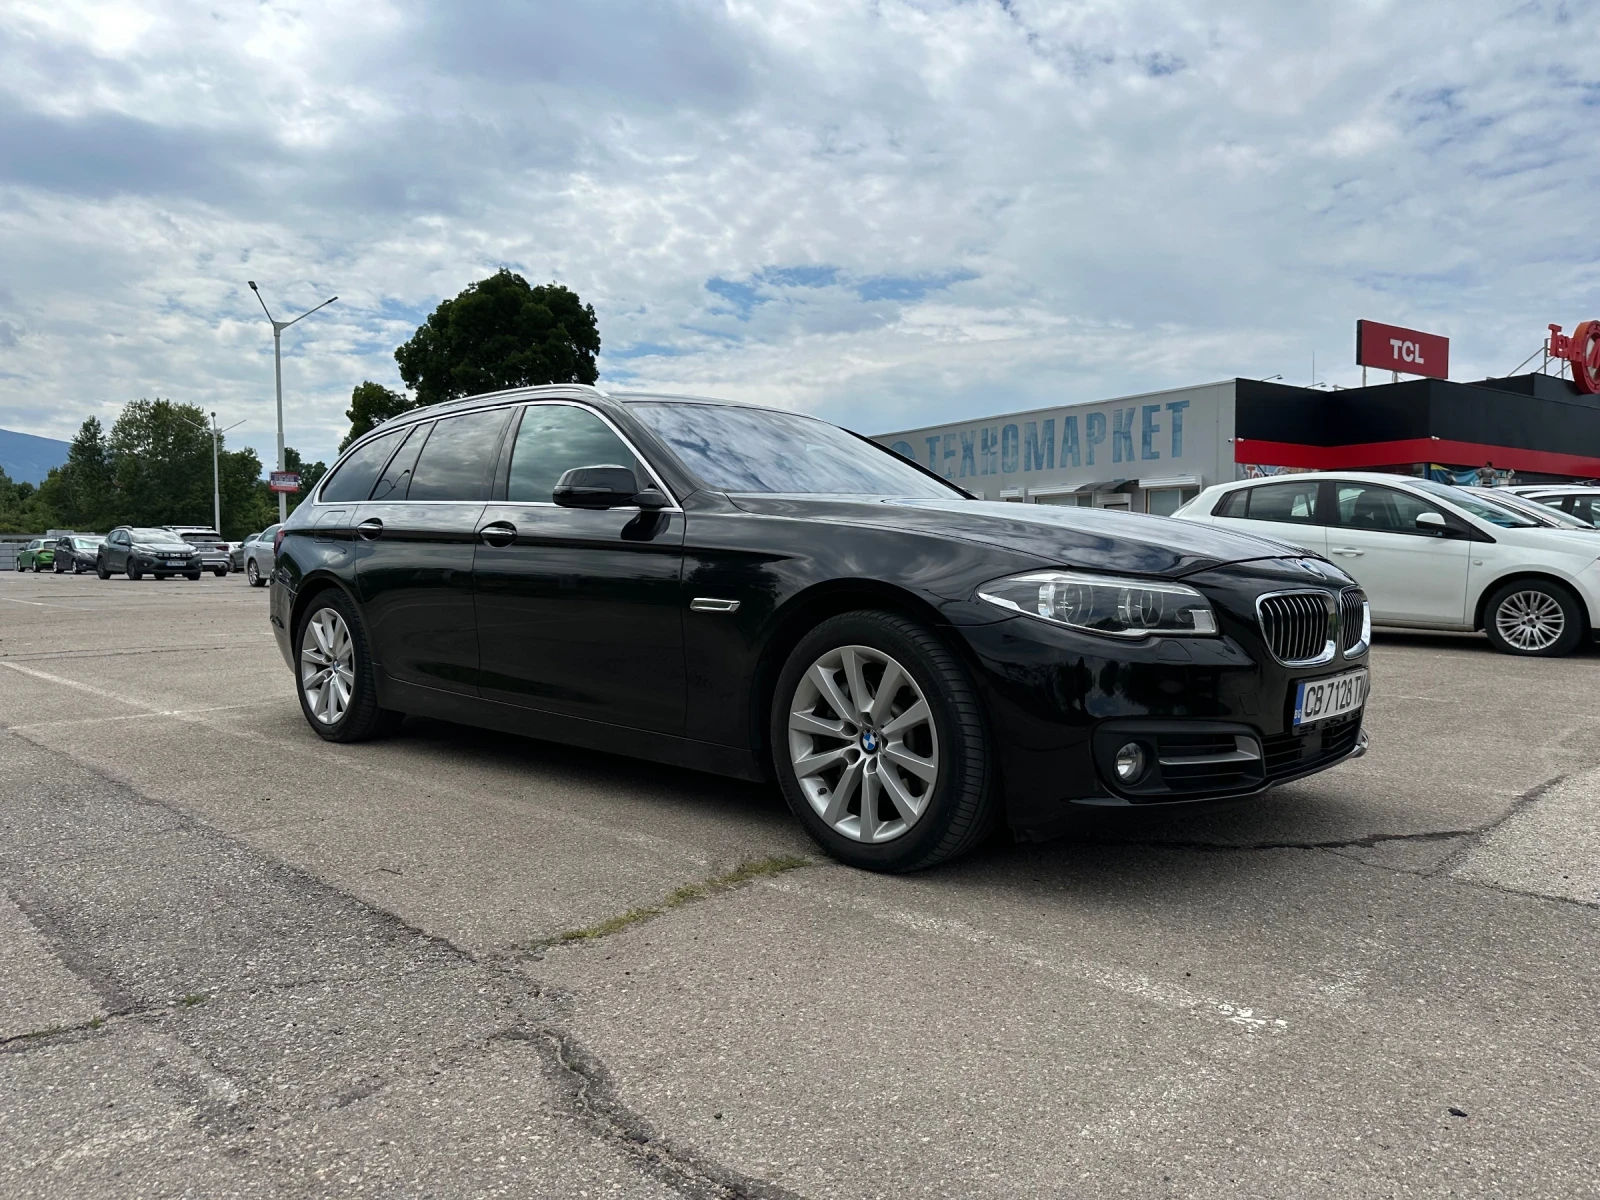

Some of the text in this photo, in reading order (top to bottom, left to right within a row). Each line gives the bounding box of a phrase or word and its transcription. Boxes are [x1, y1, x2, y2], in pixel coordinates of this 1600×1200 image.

[1390, 338, 1424, 364] TCL
[925, 400, 1190, 478] ТЕХНОМАРКЕТ
[1324, 678, 1352, 713] 7128
